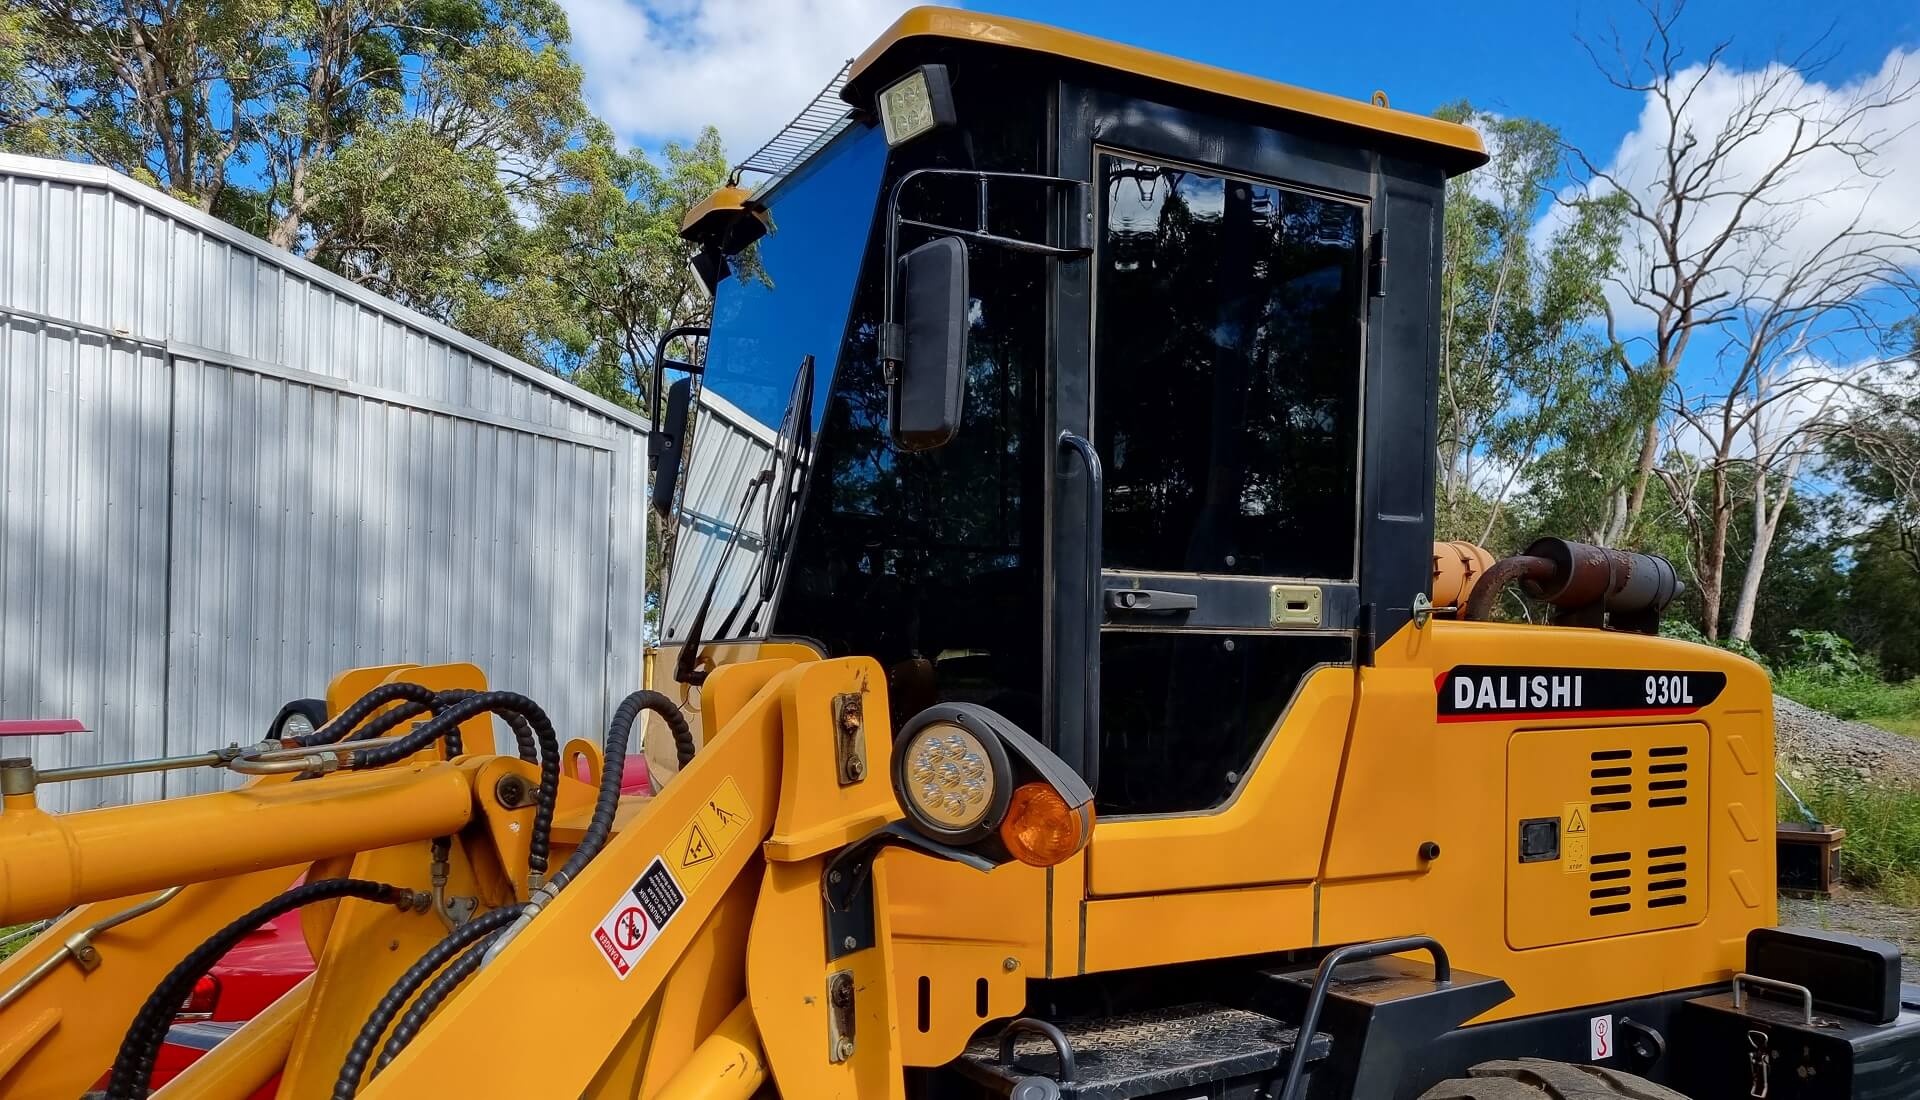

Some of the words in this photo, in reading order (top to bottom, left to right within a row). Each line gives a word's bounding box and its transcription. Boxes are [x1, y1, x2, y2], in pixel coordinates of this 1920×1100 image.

[1454, 675, 1582, 709] DALISHI
[1645, 676, 1693, 704] 930L
[637, 886, 650, 905] RISK
[646, 885, 660, 905] CLEAR
[646, 900, 663, 924] CRUSH
[656, 900, 668, 918] KEEP
[597, 931, 620, 961] DANGER
